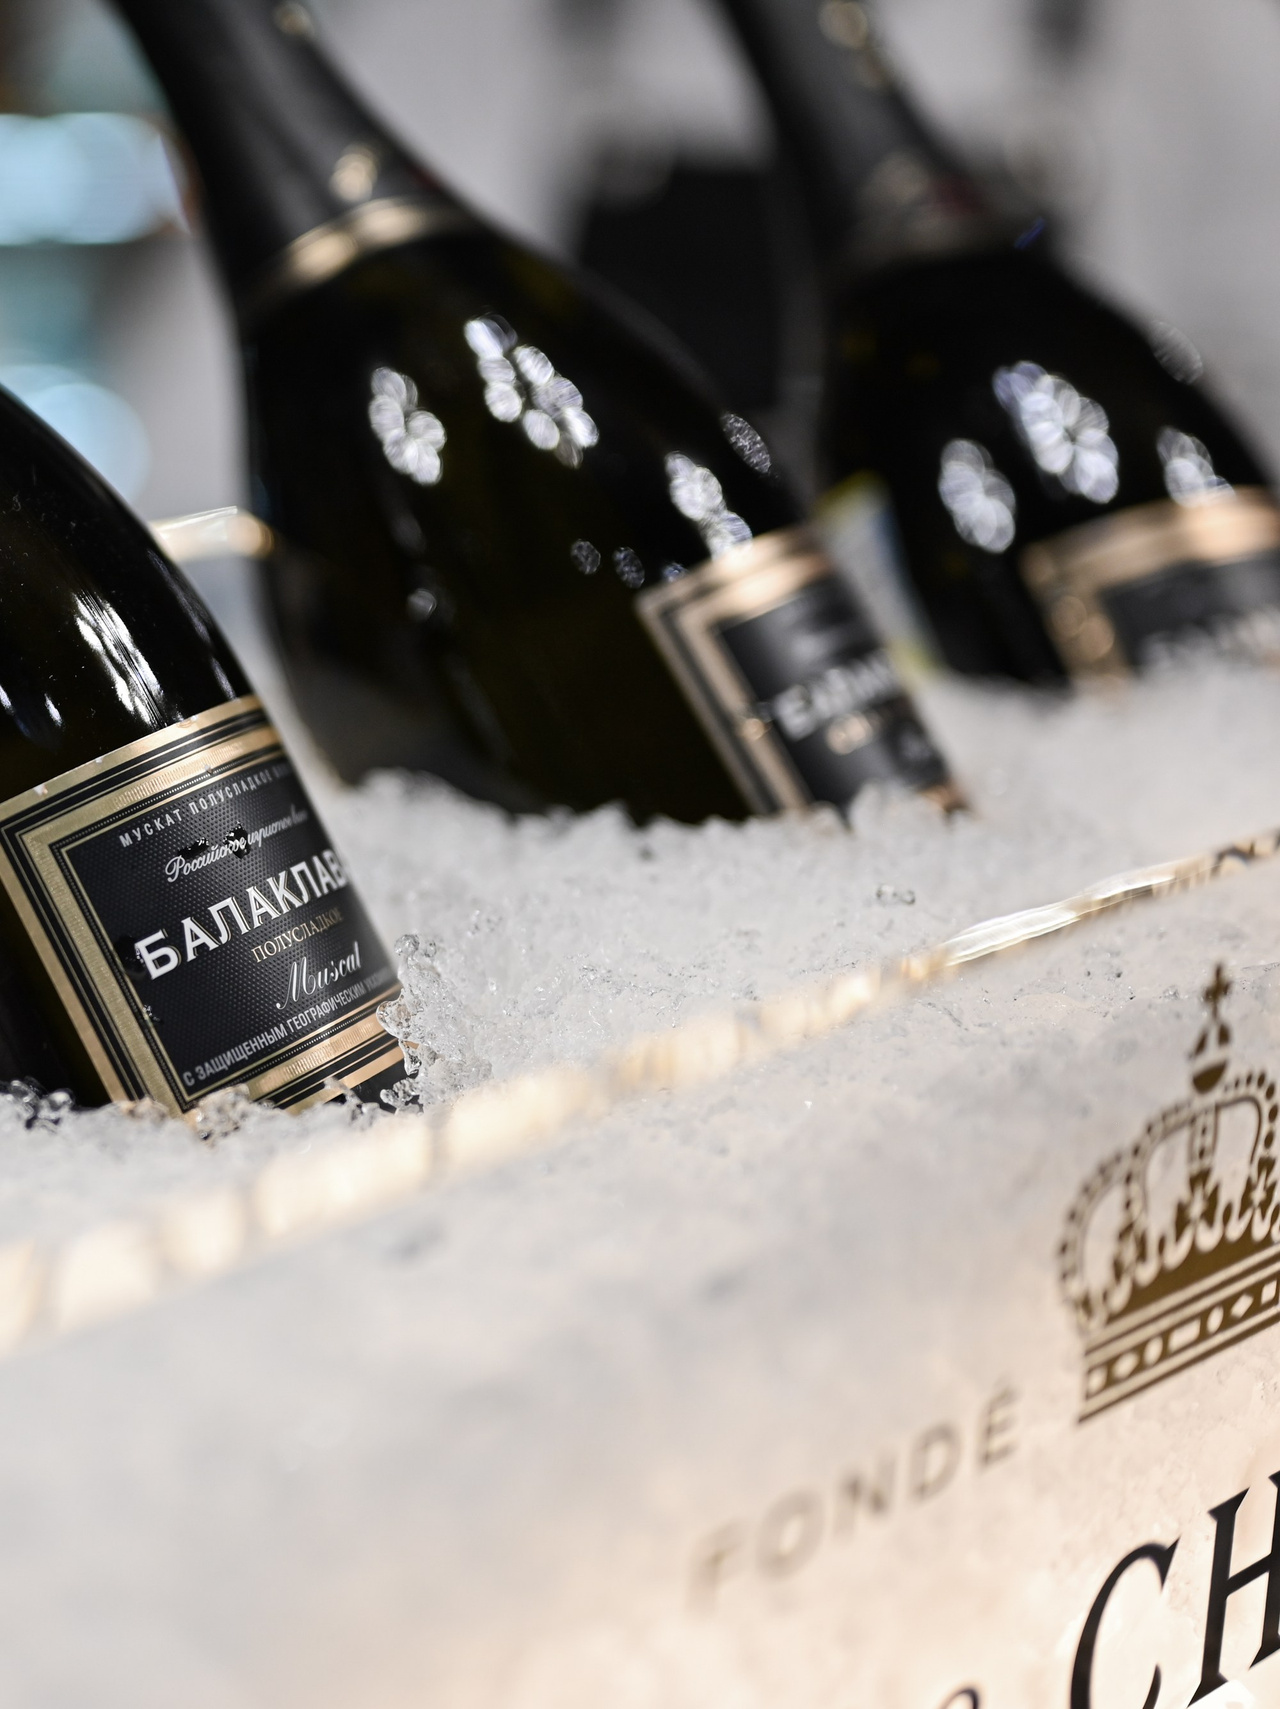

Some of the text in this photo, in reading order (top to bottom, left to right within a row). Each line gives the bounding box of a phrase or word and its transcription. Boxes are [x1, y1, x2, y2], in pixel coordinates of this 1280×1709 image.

[119, 808, 184, 848] МУСКАТ
[189, 767, 275, 816] ПОЛУСЛАДКОЕ
[134, 848, 350, 981] БАЛАКЛАВ
[182, 1069, 196, 1087] С
[196, 1021, 289, 1081] ЗАЩИЩЕННЫМ
[285, 976, 368, 1038] ГЕОГРАФИЧЕСКИМ
